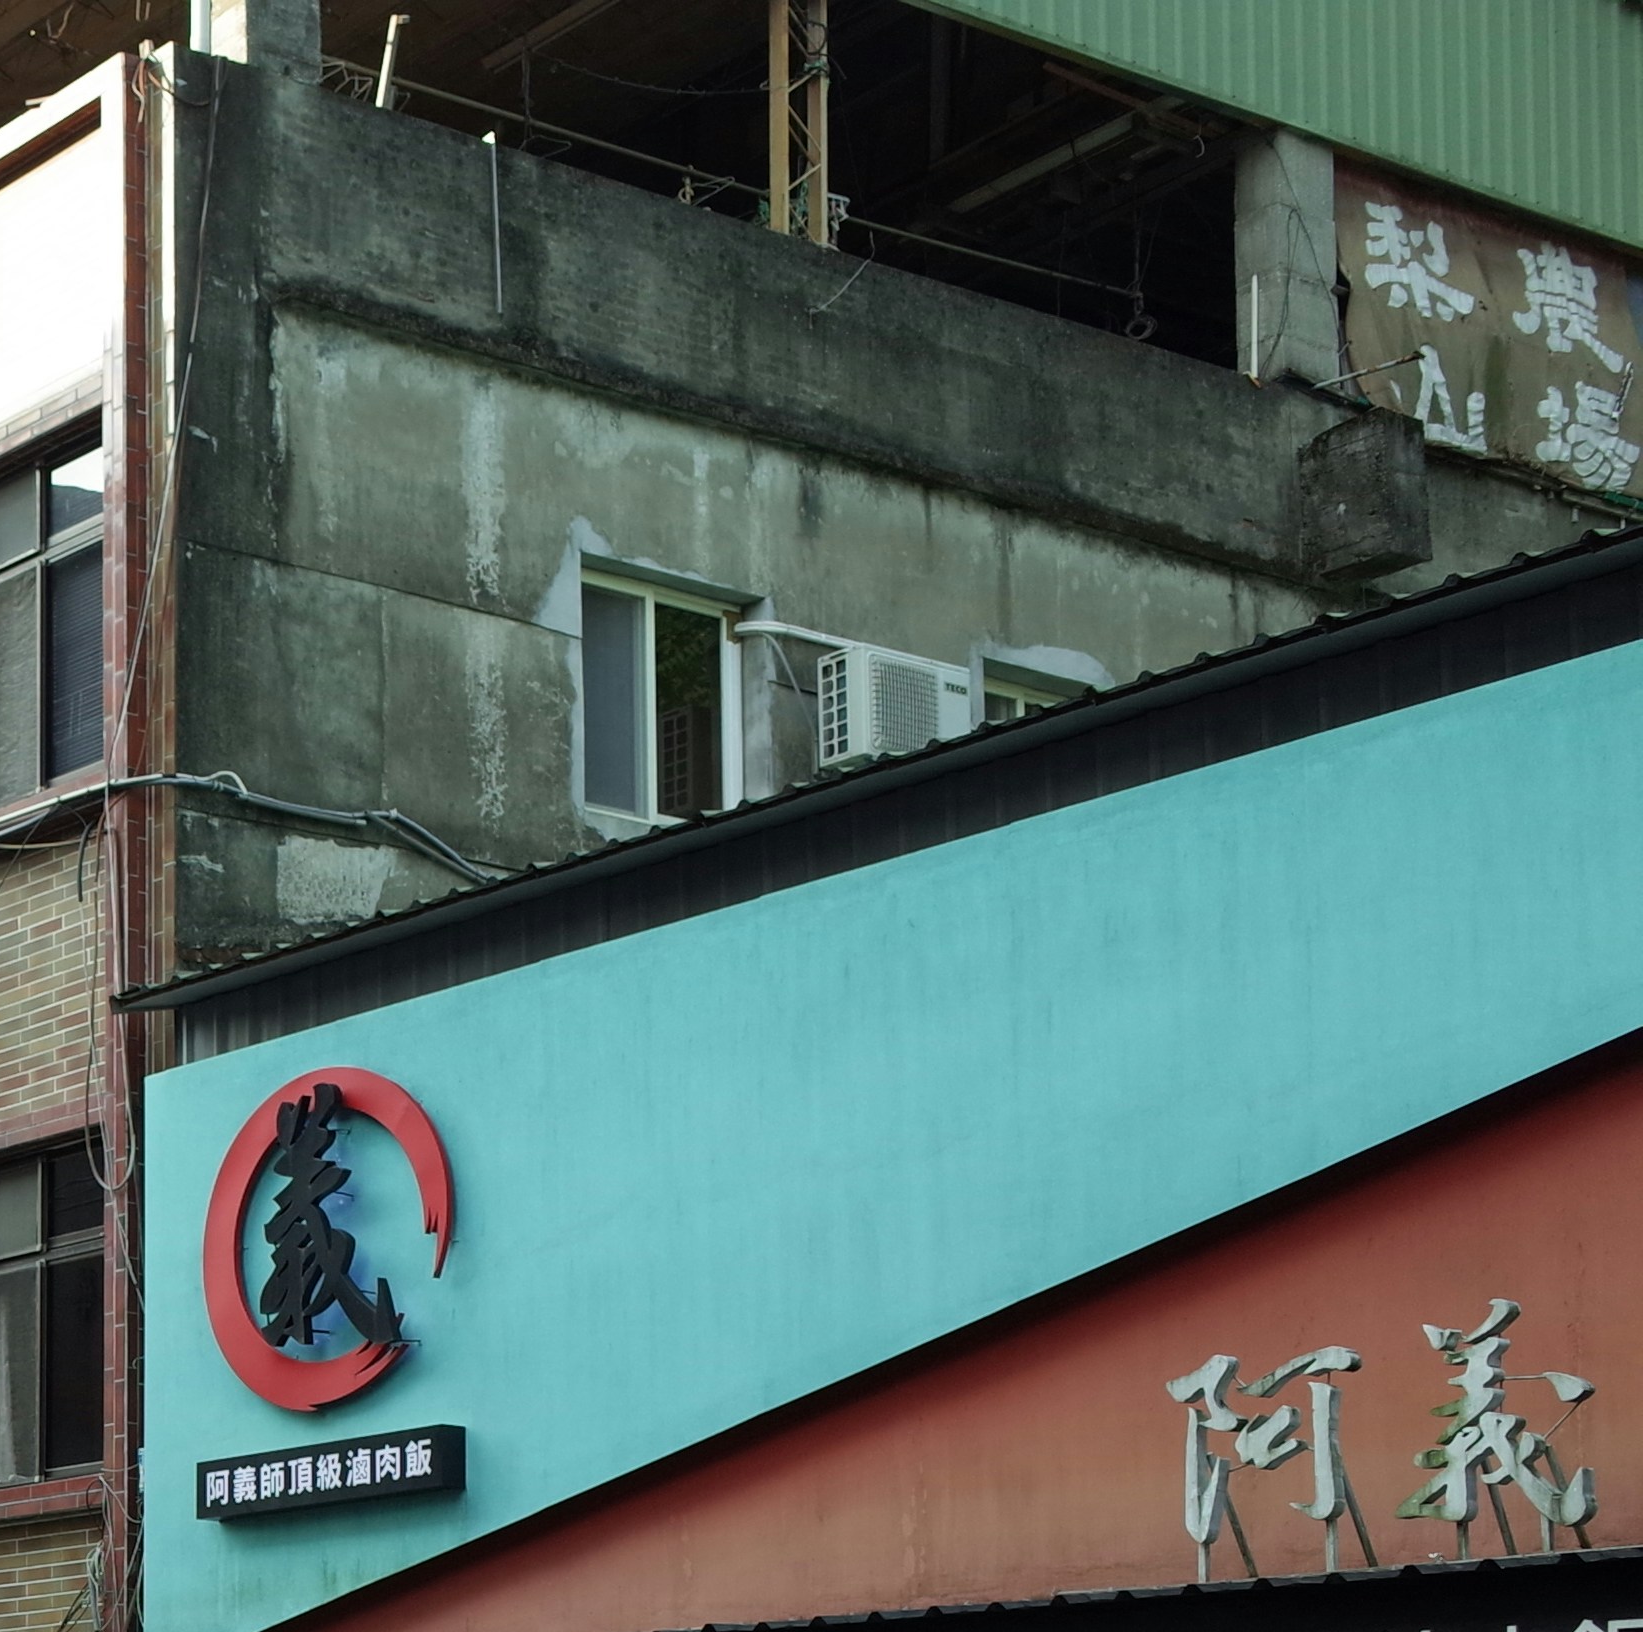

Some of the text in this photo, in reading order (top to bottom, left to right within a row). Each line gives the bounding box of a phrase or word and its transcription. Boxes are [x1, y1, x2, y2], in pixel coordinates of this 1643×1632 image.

[205, 1438, 433, 1508] 阿義師頂級滷肉飯
[1165, 1298, 1599, 1545] 阿義
